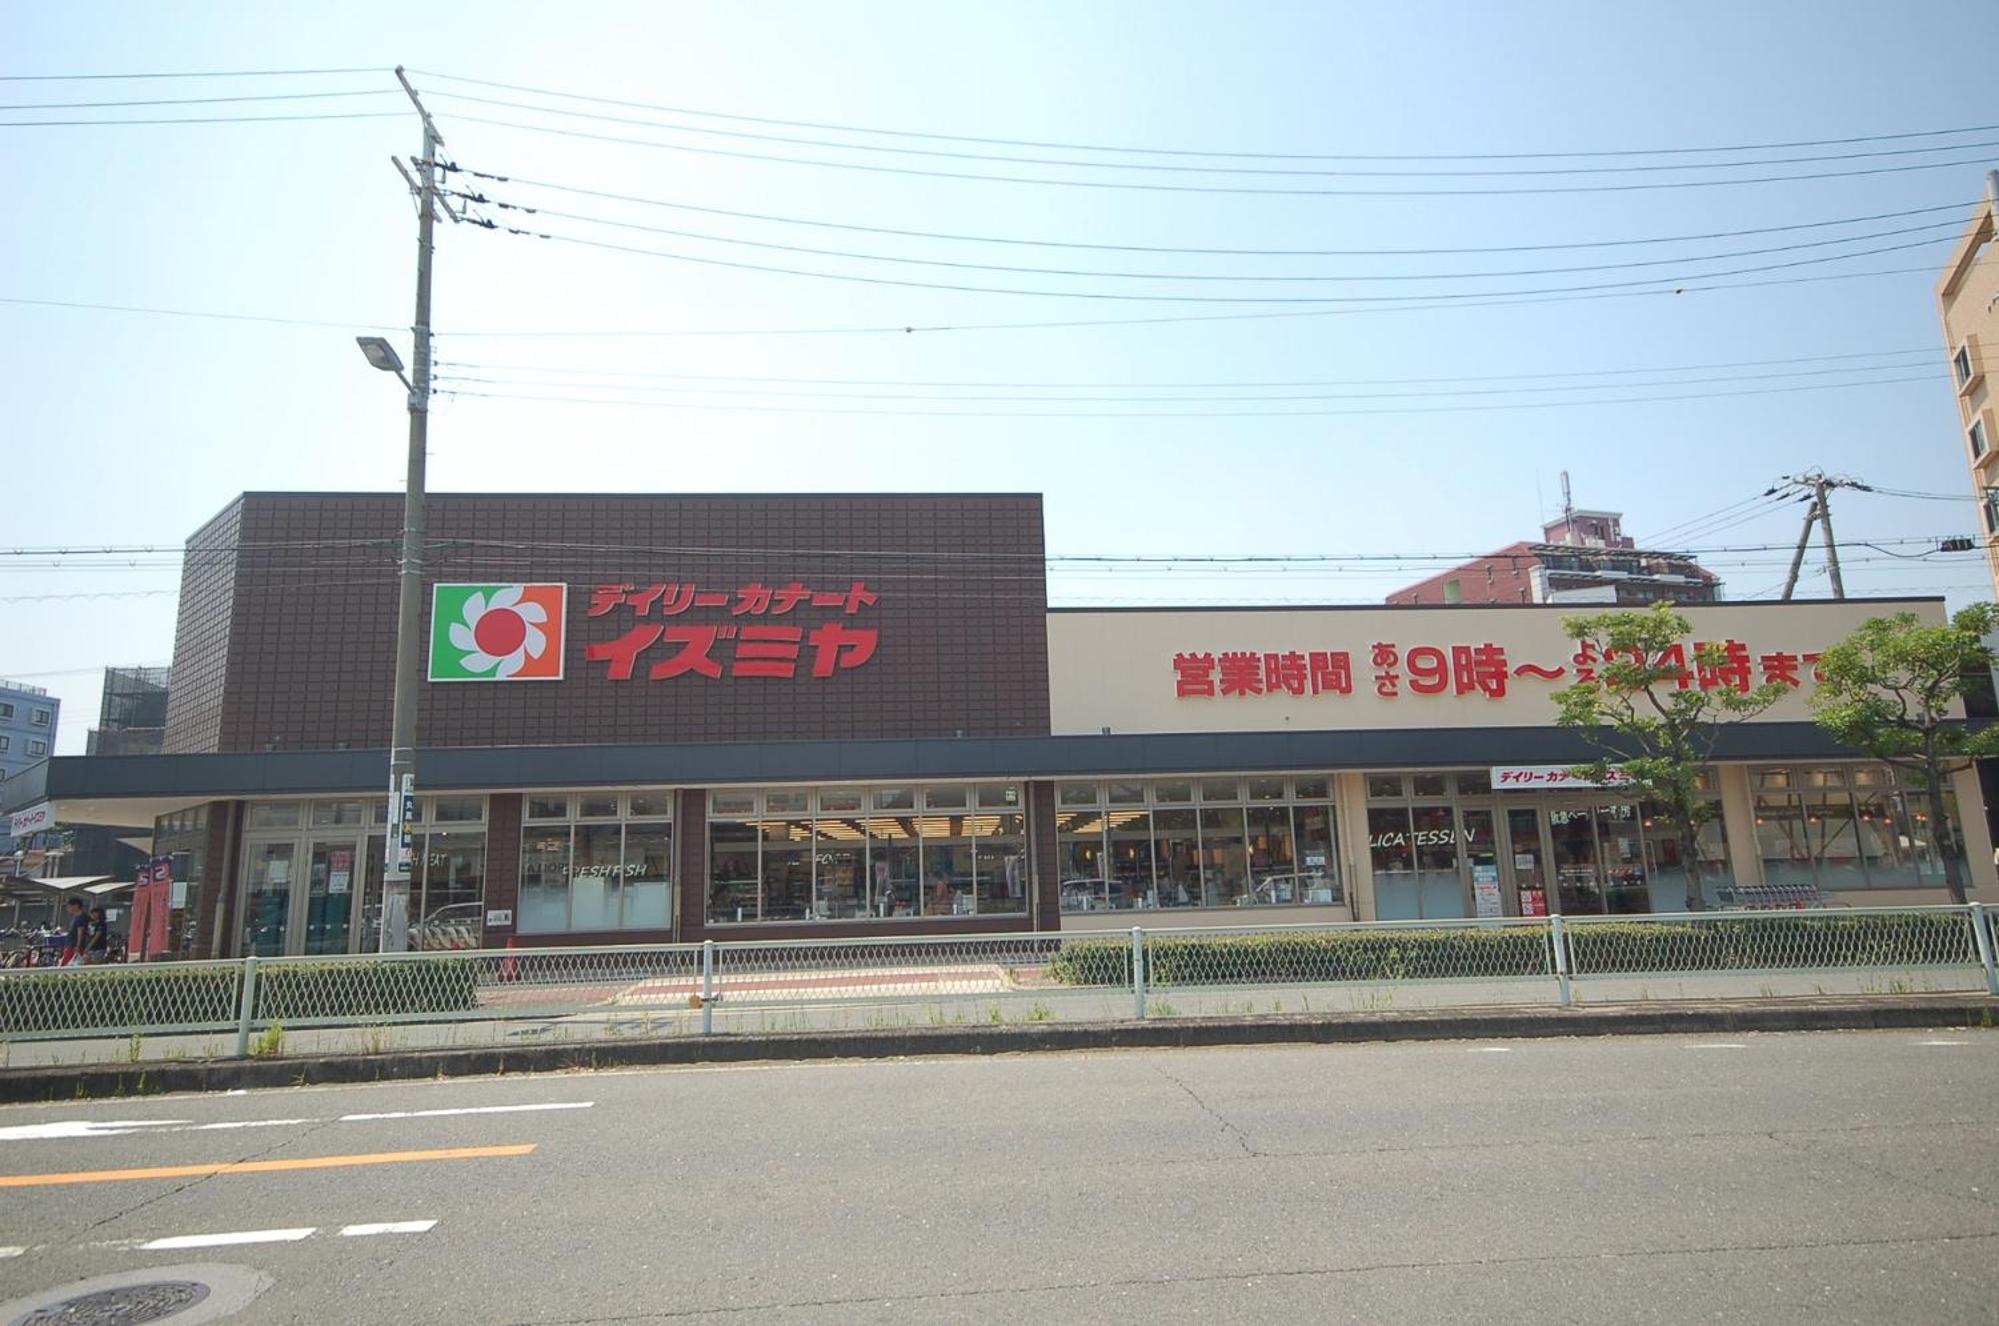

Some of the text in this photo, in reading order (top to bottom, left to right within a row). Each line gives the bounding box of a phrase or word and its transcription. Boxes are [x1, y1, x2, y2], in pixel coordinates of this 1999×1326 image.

[586, 623, 878, 680] イズミヤ
[1173, 651, 1354, 698] 営業時間
